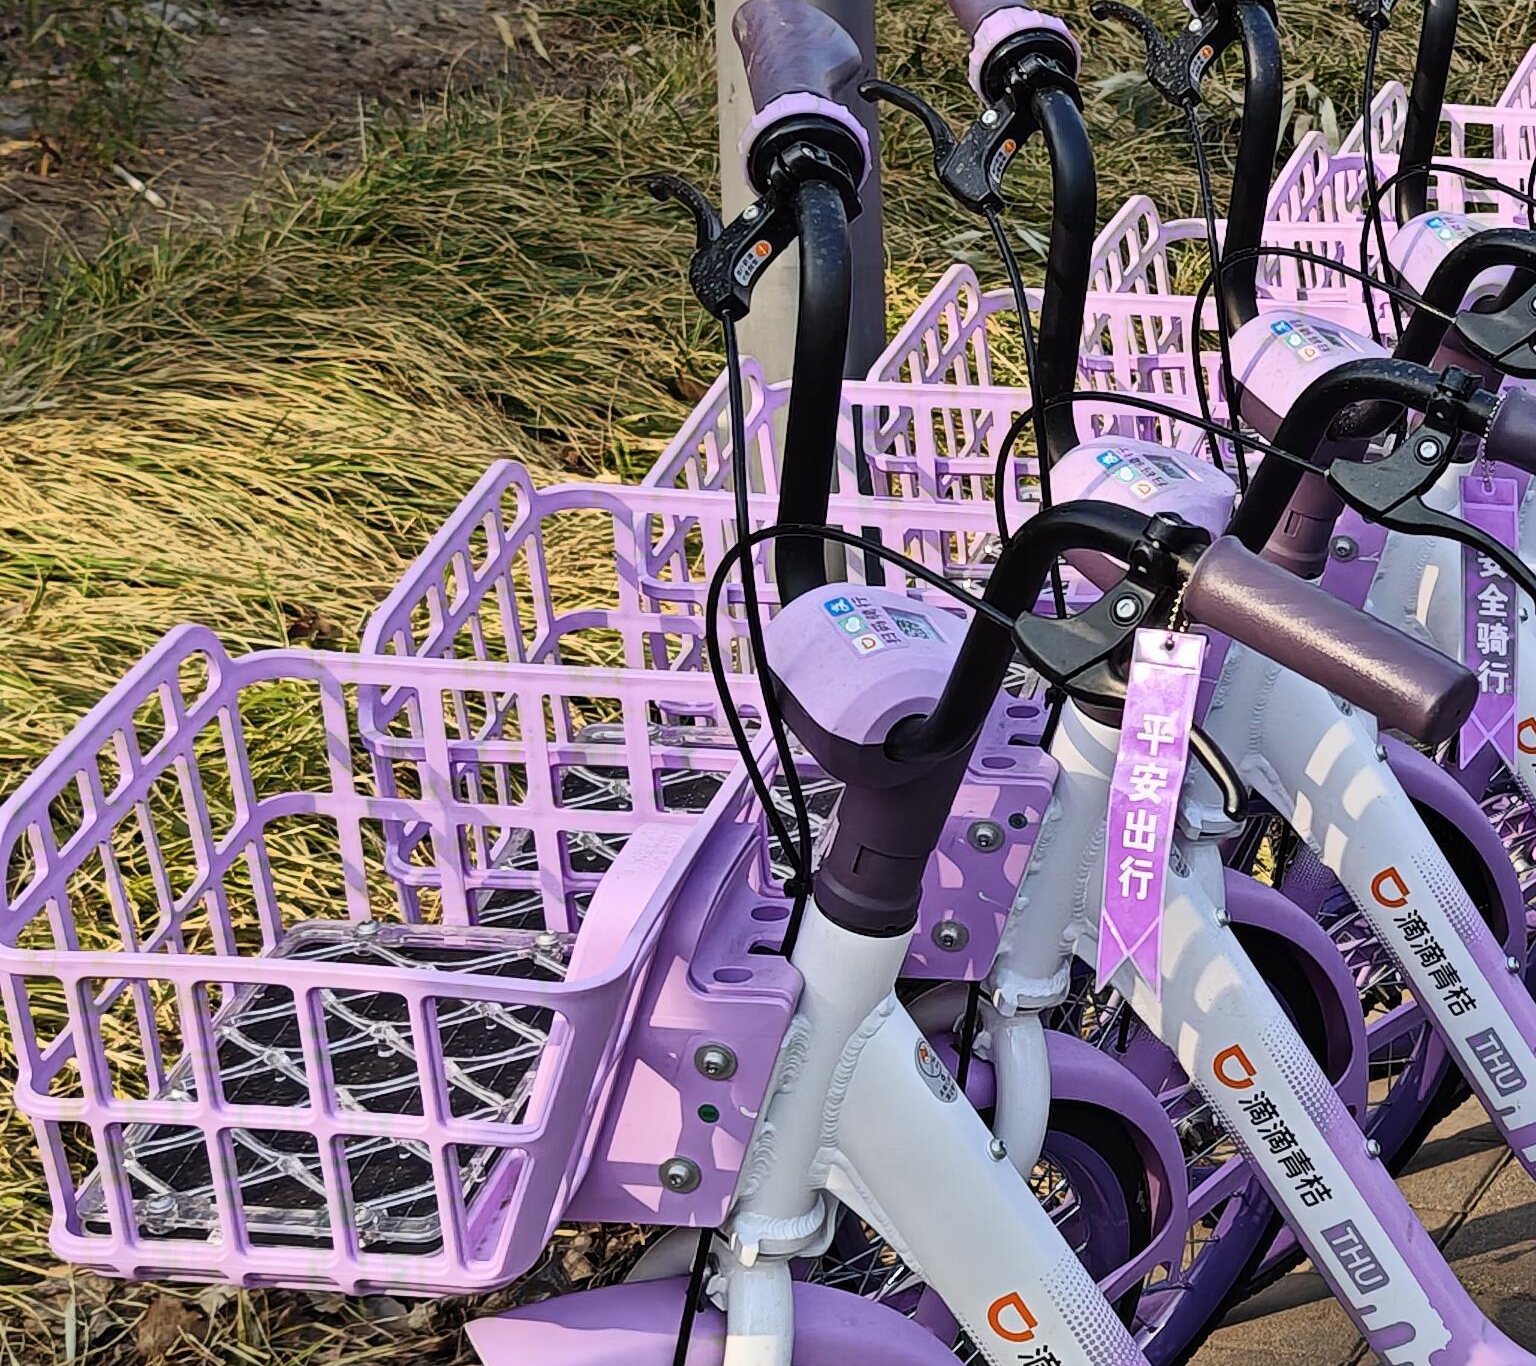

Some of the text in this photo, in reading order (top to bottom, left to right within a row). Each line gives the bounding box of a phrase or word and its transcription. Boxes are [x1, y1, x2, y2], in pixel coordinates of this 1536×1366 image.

[1117, 713, 1175, 901] 平安出行
[1393, 908, 1477, 1018] 滴滴青桔
[1472, 1032, 1524, 1091] THU
[1237, 1089, 1333, 1208] 滴滴青桔
[1328, 1225, 1384, 1290] THU
